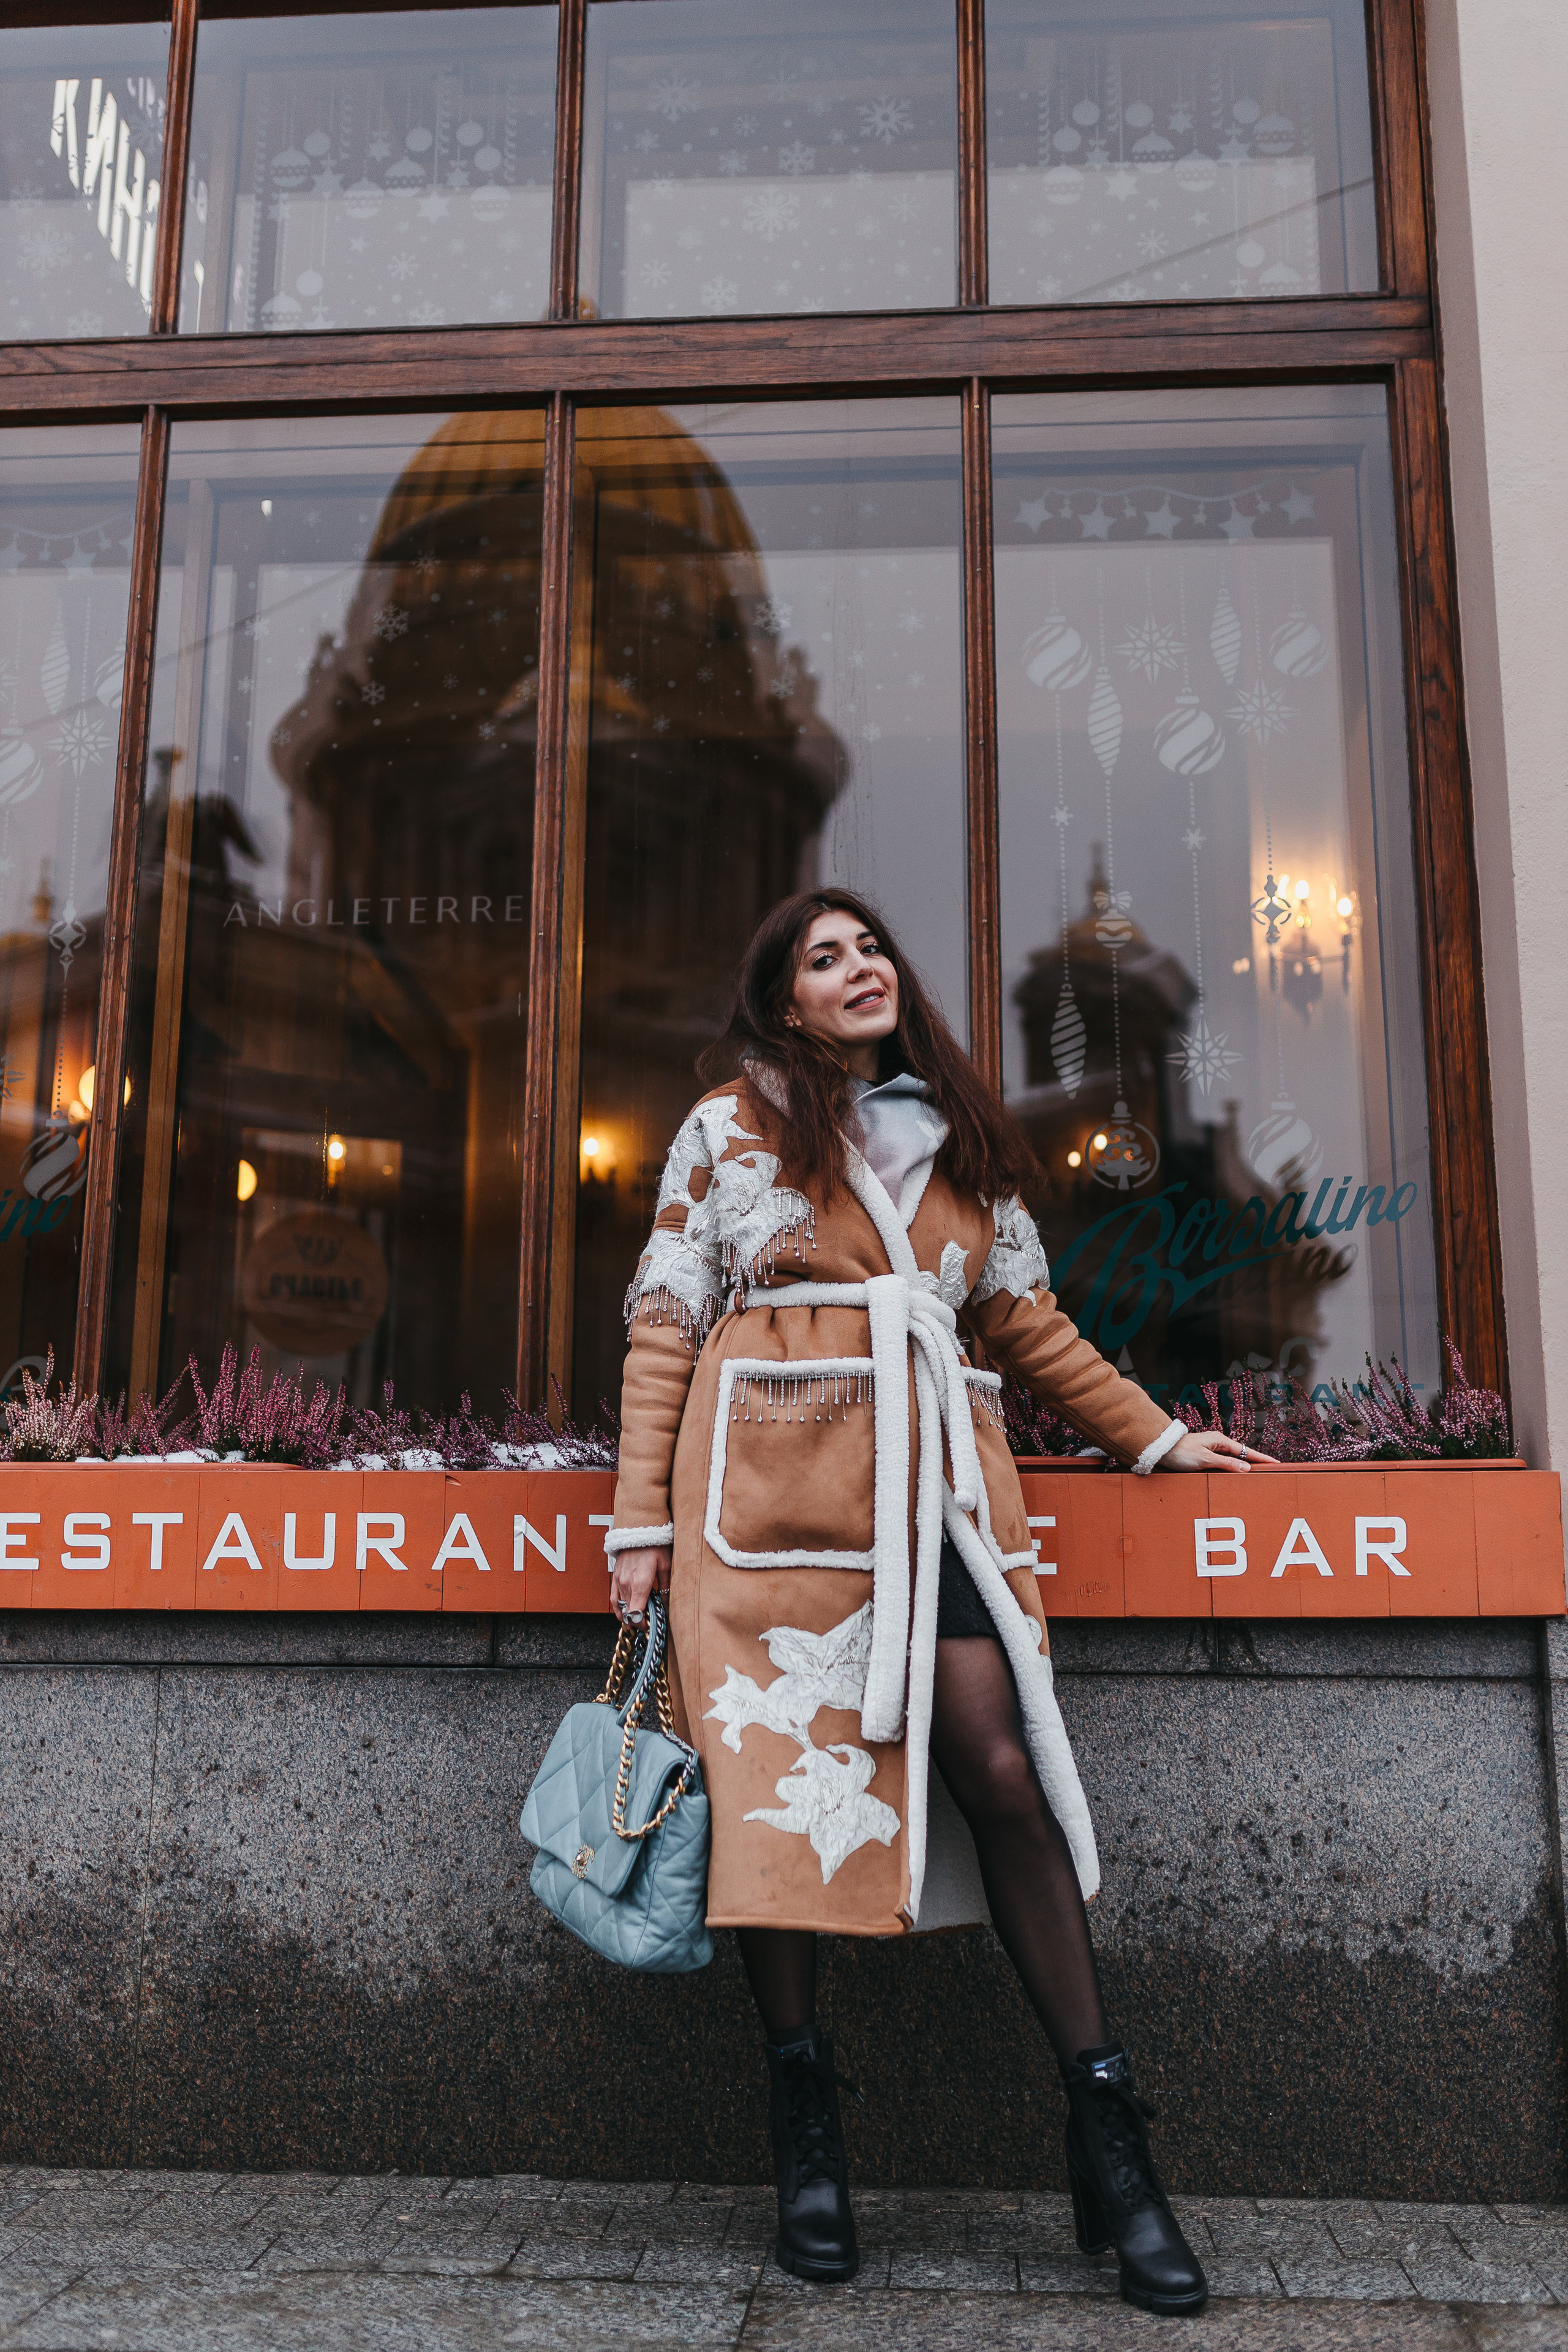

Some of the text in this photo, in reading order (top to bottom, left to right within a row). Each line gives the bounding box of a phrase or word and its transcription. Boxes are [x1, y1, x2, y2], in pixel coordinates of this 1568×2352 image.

[223, 895, 524, 927] ANGLETERRE
[1049, 1175, 1418, 1351] Borsalino
[1142, 1383, 1425, 1408] TAURANT
[1194, 1516, 1412, 1577] BAR
